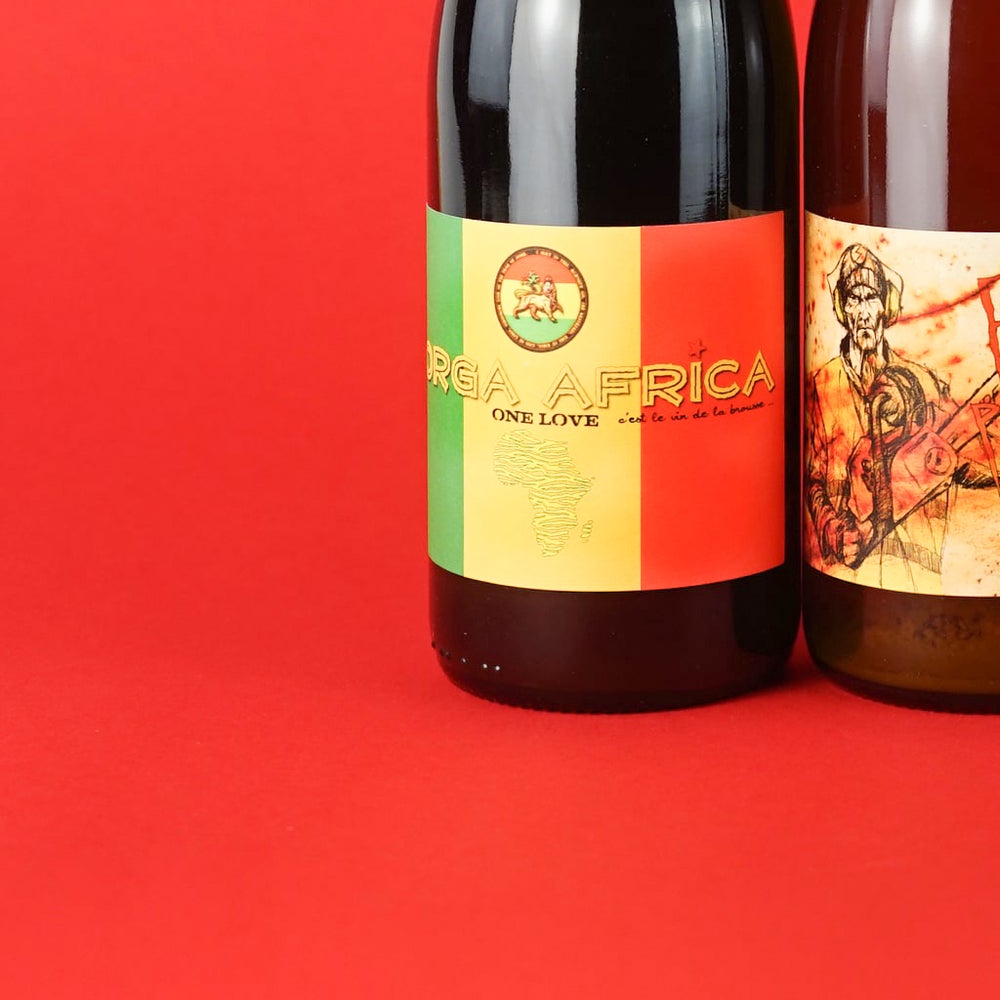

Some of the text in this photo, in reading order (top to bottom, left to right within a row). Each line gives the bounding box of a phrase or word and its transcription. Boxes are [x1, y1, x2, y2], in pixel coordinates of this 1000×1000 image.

[543, 350, 775, 409] AFRICA
[492, 408, 599, 427] ONE LOVE
[618, 412, 646, 423] c'est
[652, 412, 664, 422] le
[671, 412, 688, 421] vin
[693, 409, 707, 418] de
[713, 406, 726, 417] la
